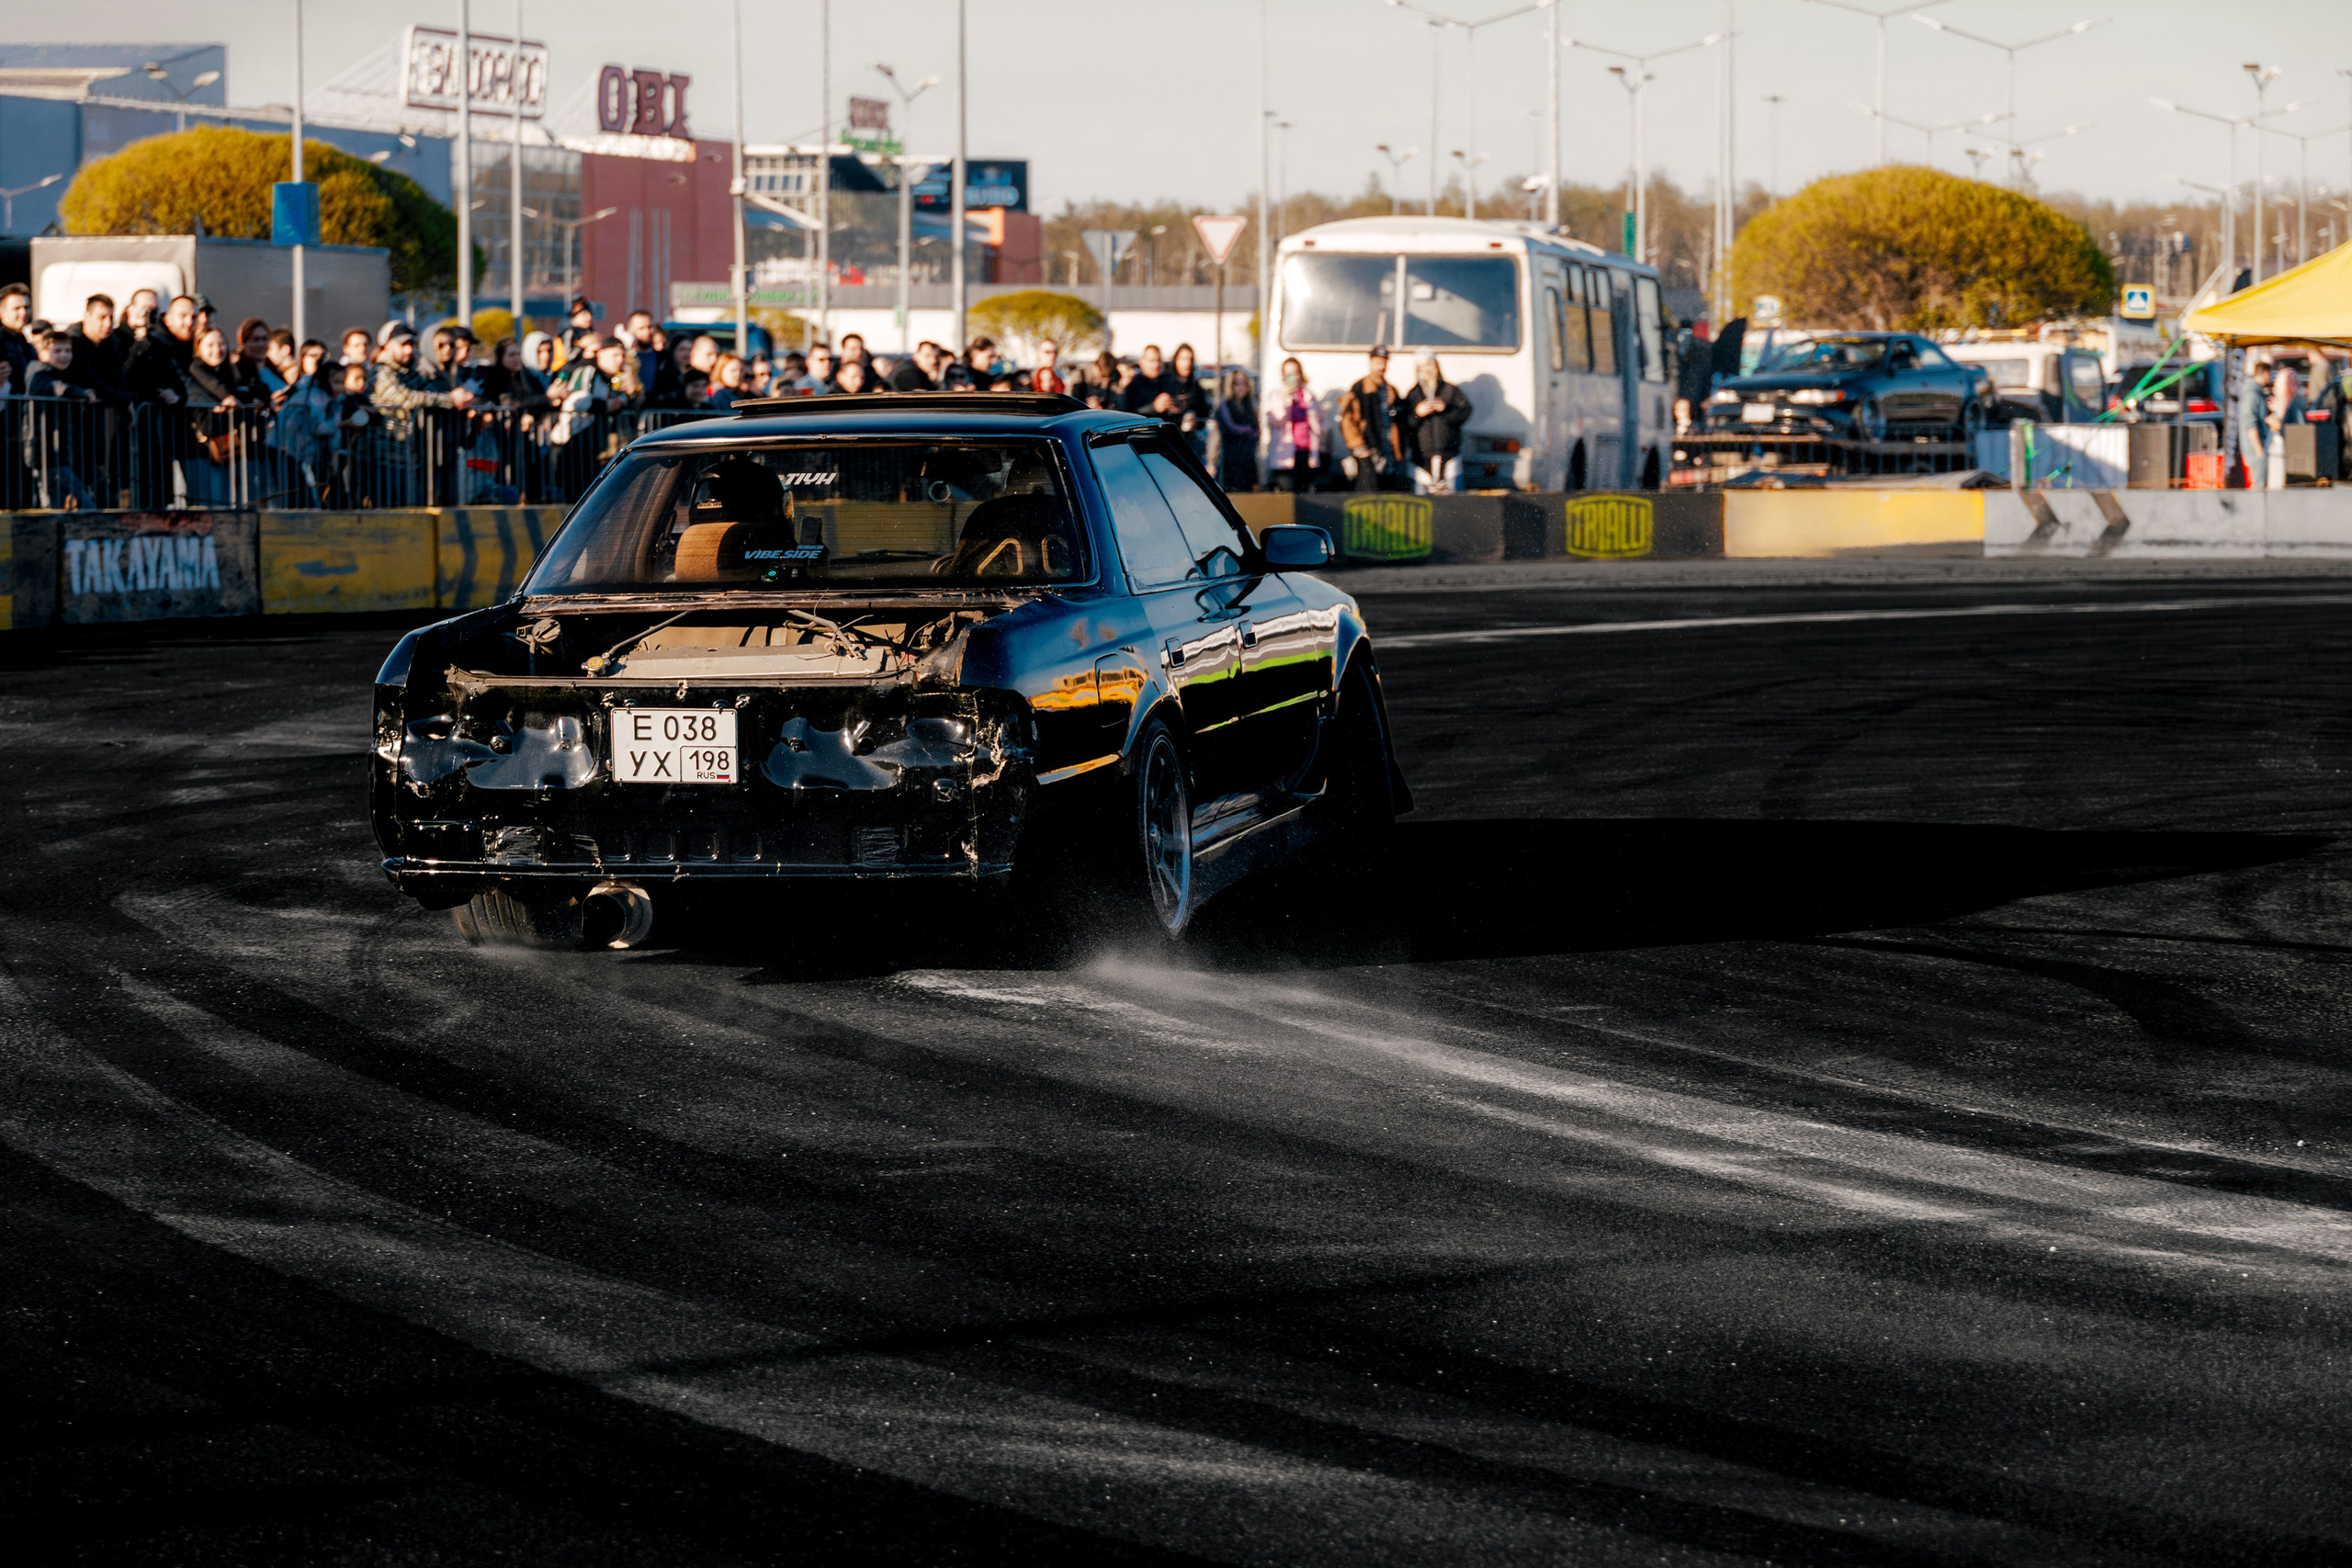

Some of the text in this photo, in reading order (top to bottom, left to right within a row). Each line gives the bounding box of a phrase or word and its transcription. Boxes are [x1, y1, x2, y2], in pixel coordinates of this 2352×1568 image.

[598, 65, 692, 140] OBI
[65, 536, 220, 595] TAKAYAMA
[744, 550, 822, 559] VIBE SIDE
[663, 716, 717, 741] 038
[689, 750, 729, 770] 198
[696, 772, 716, 780] RUS
